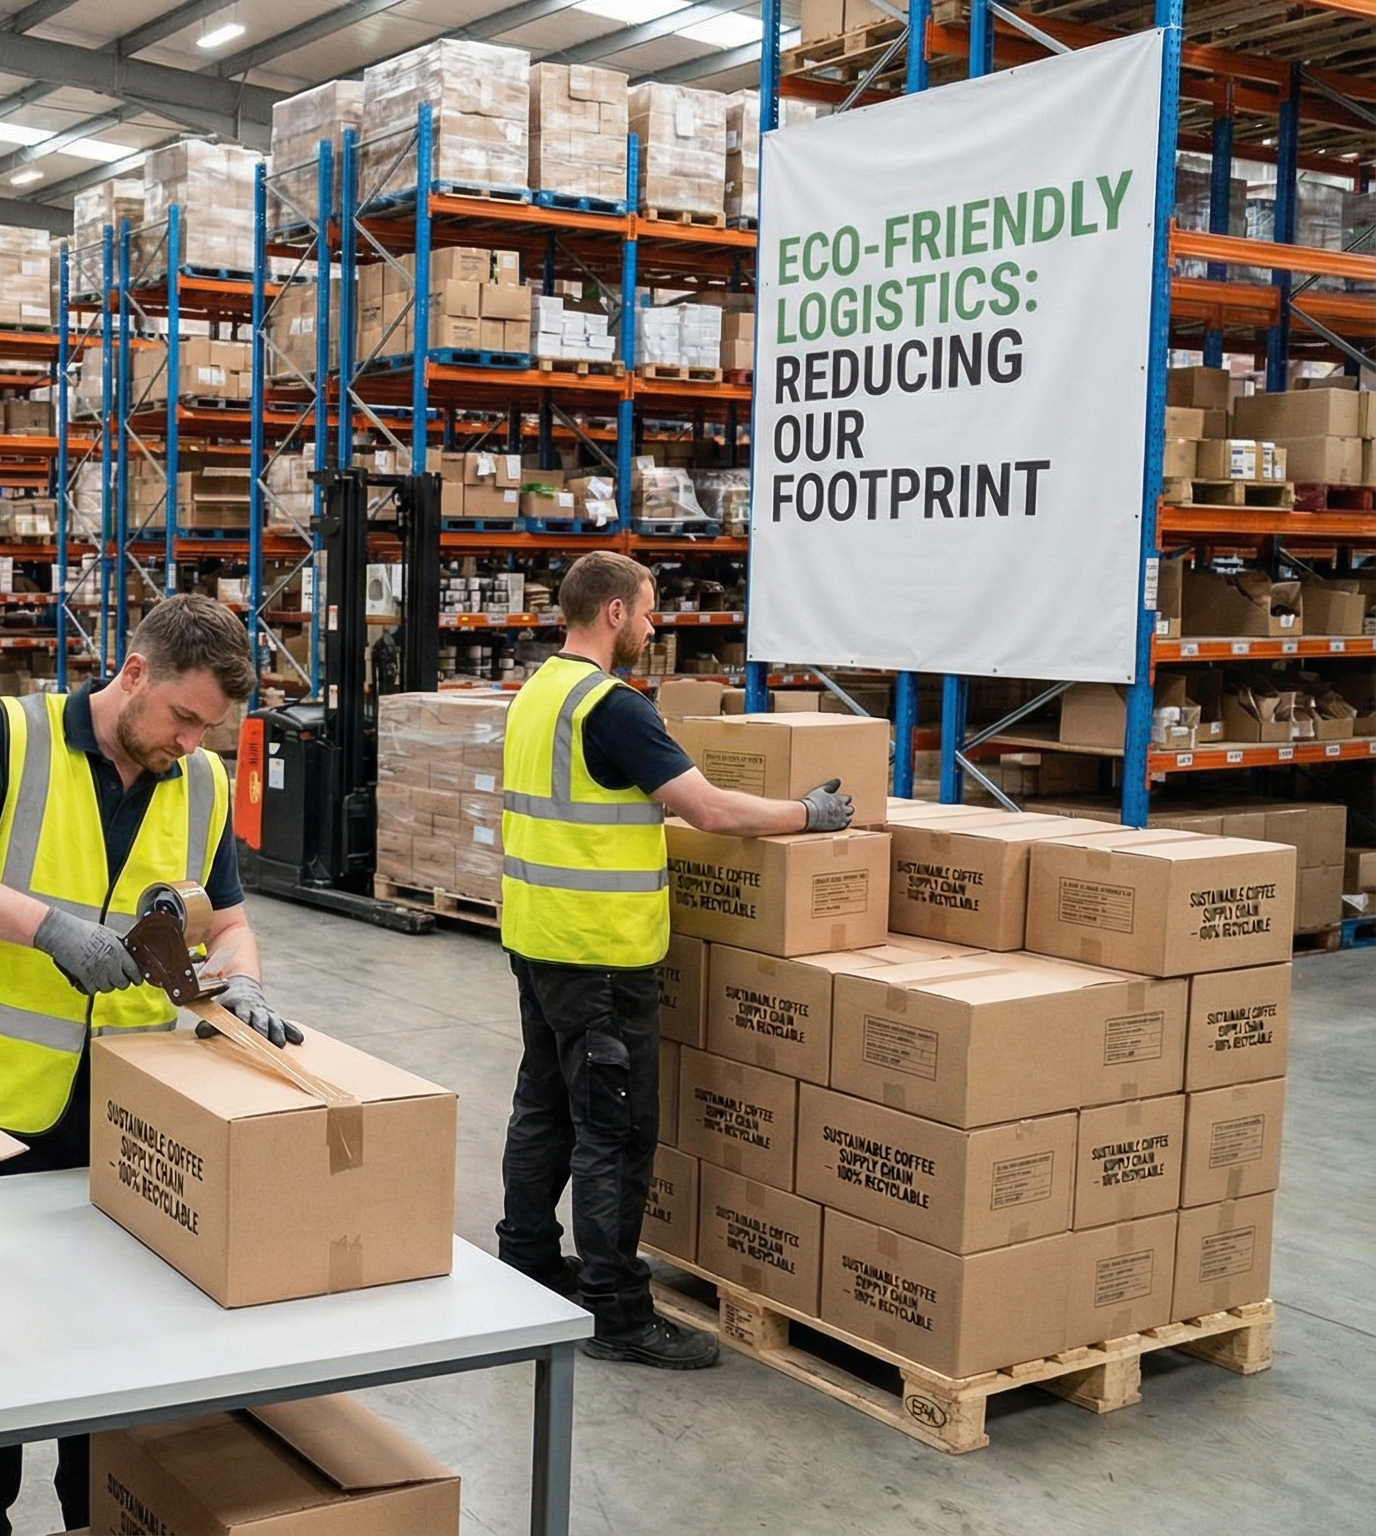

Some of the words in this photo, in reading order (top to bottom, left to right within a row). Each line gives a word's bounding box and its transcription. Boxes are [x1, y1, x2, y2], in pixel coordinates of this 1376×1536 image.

[778, 169, 1134, 286] ECO-FRIENDLY
[776, 260, 1038, 345] LOGISTICS:
[774, 328, 1024, 405] REDUCING
[773, 409, 865, 464] OUR
[772, 460, 1050, 523] FOOTPRINT
[108, 1100, 165, 1157] SUSTAINABLE
[168, 1139, 203, 1182] COFFEE
[121, 1135, 154, 1176] SUPPLY
[156, 1158, 184, 1198] CHAIN
[823, 1125, 892, 1162] SUSTAINABLE
[894, 1149, 935, 1176] COFFEE
[839, 1148, 878, 1174] SUPPLY
[142, 1174, 198, 1235] RECYCLABLE
